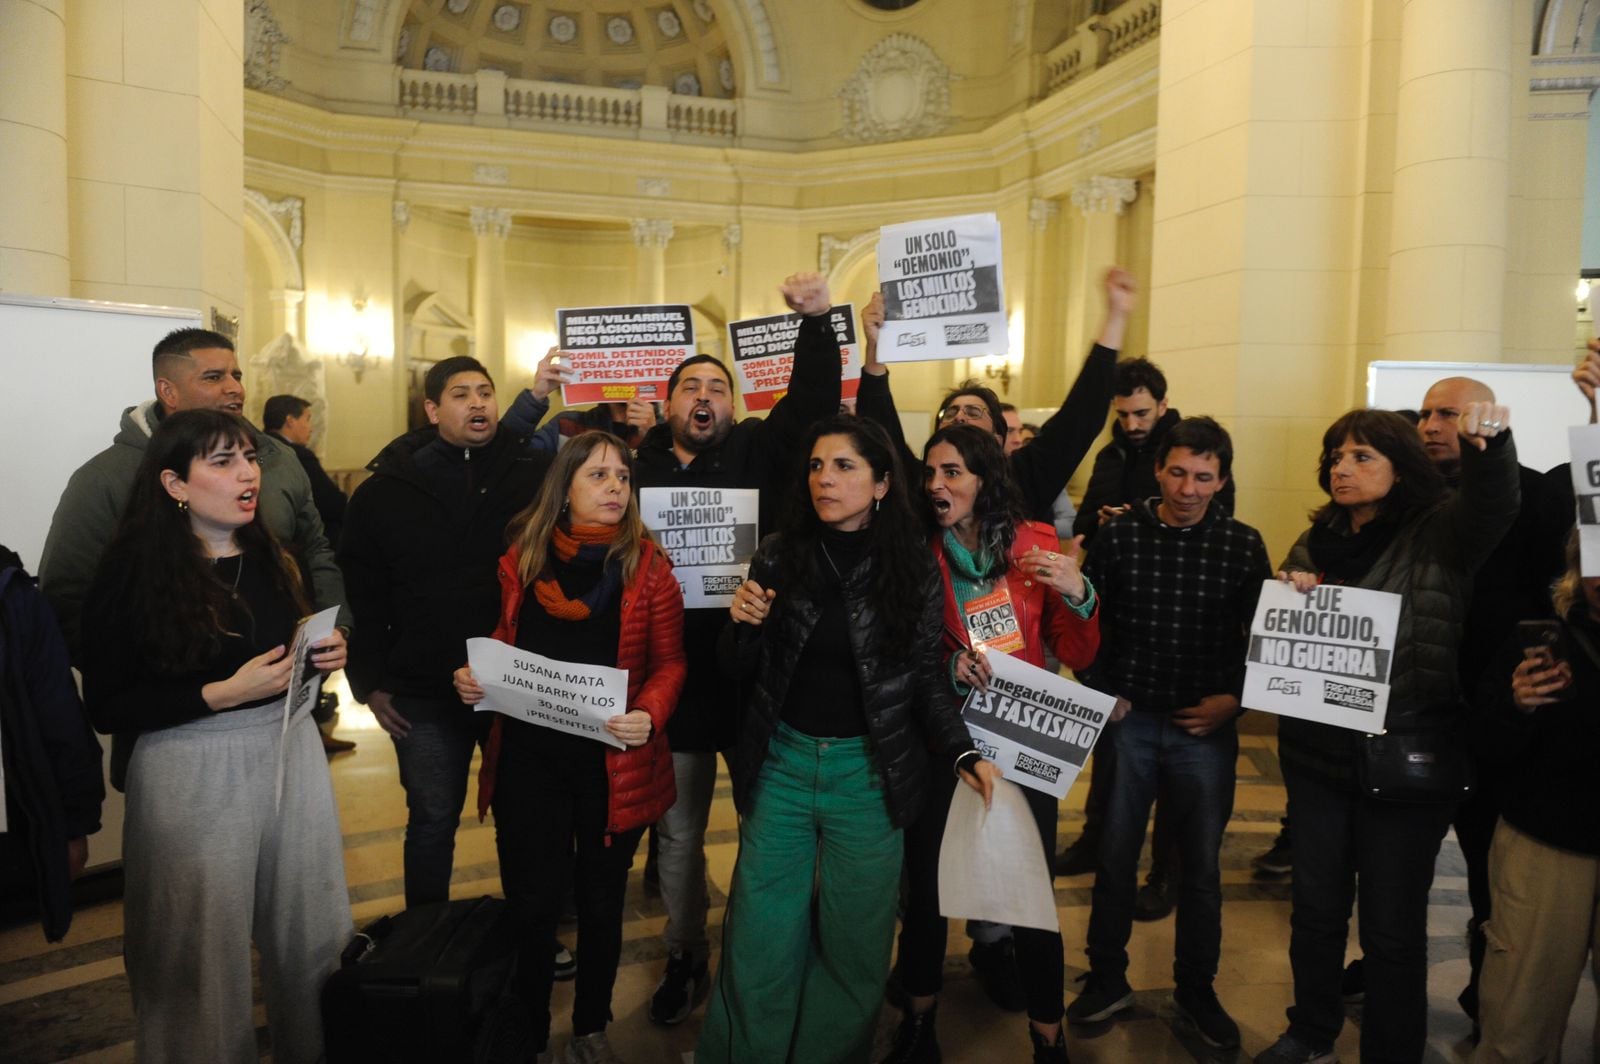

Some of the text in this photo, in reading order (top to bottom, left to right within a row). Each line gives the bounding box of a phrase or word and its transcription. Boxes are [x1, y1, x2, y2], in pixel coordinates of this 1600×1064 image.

[905, 230, 957, 255] UN SOLO
[897, 270, 977, 301] LOS MILICOS
[903, 290, 978, 319] GENOCIDAS
[566, 312, 685, 326] MILEI/VILLARRUEL
[566, 322, 686, 336] NEGACIONISTAS
[566, 332, 686, 347] PRO DICTADURA
[740, 345, 766, 357] PRO
[571, 357, 684, 369] DESAPARECIDOS
[611, 348, 687, 359] DETENIDOS
[671, 490, 722, 508] UN SOLO
[661, 526, 737, 549] LOS MILICOS
[1304, 586, 1344, 613] FUE
[1264, 608, 1380, 648] GENOCIDIO,
[1260, 637, 1377, 678] NO GUERRA
[513, 659, 605, 688] SUSANA MATA
[502, 673, 616, 708] JUAN BARRY Y LOS
[994, 677, 1104, 724] negacionismo
[1325, 681, 1360, 697] FRENTE
[970, 690, 1098, 749] ES FASCISMO
[1015, 759, 1058, 780] IZQUIERDA
[1018, 753, 1051, 770] FRENTE
